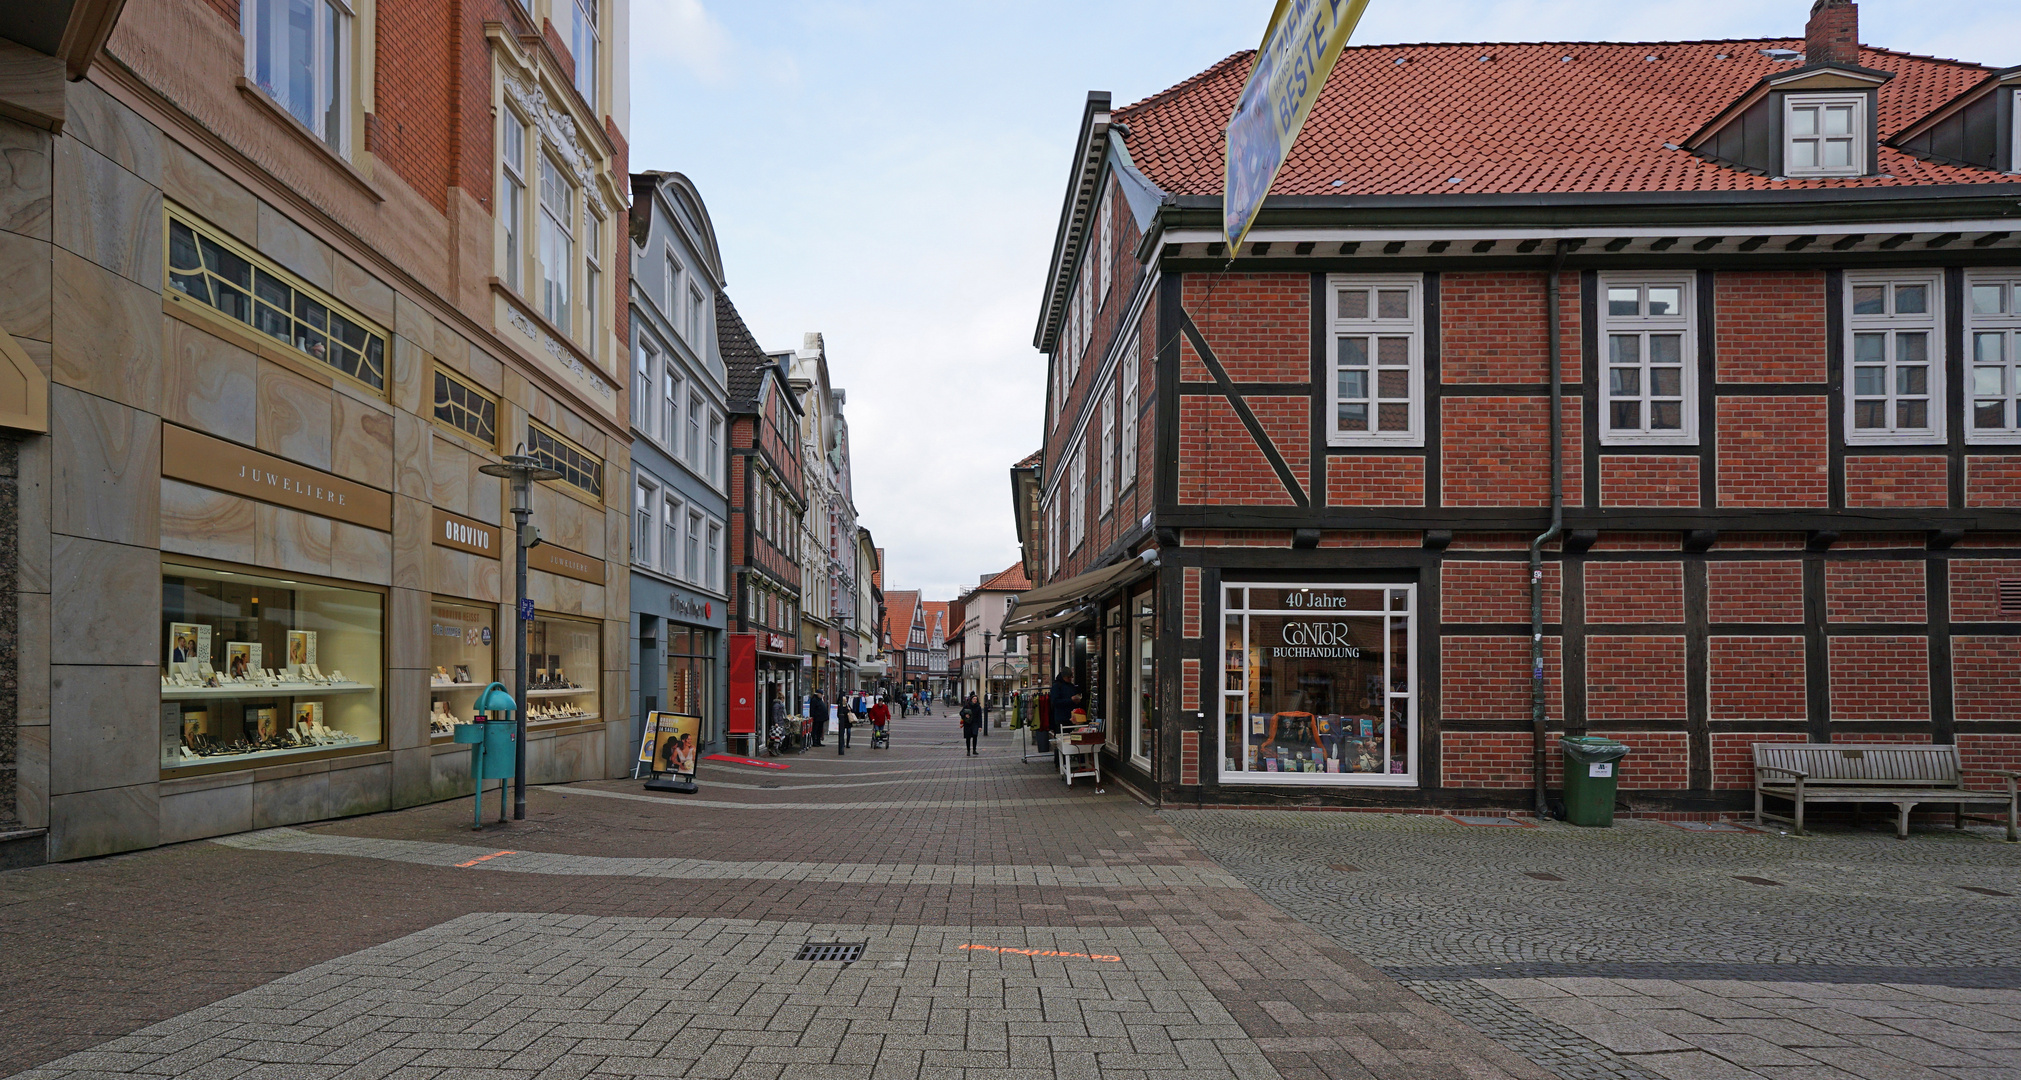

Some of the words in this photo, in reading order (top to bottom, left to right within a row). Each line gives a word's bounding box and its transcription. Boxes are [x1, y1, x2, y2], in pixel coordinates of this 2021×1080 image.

[1274, 55, 1291, 99] HANS
[1279, 10, 1327, 136] BESTE
[239, 465, 346, 506] JUWELIERE
[445, 520, 489, 550] OROVIVO
[550, 555, 588, 573] JUWELIERE
[1286, 592, 1303, 607] 40
[1306, 593, 1347, 608] Jahre
[1273, 647, 1360, 658] BUCHHANDLUNG
